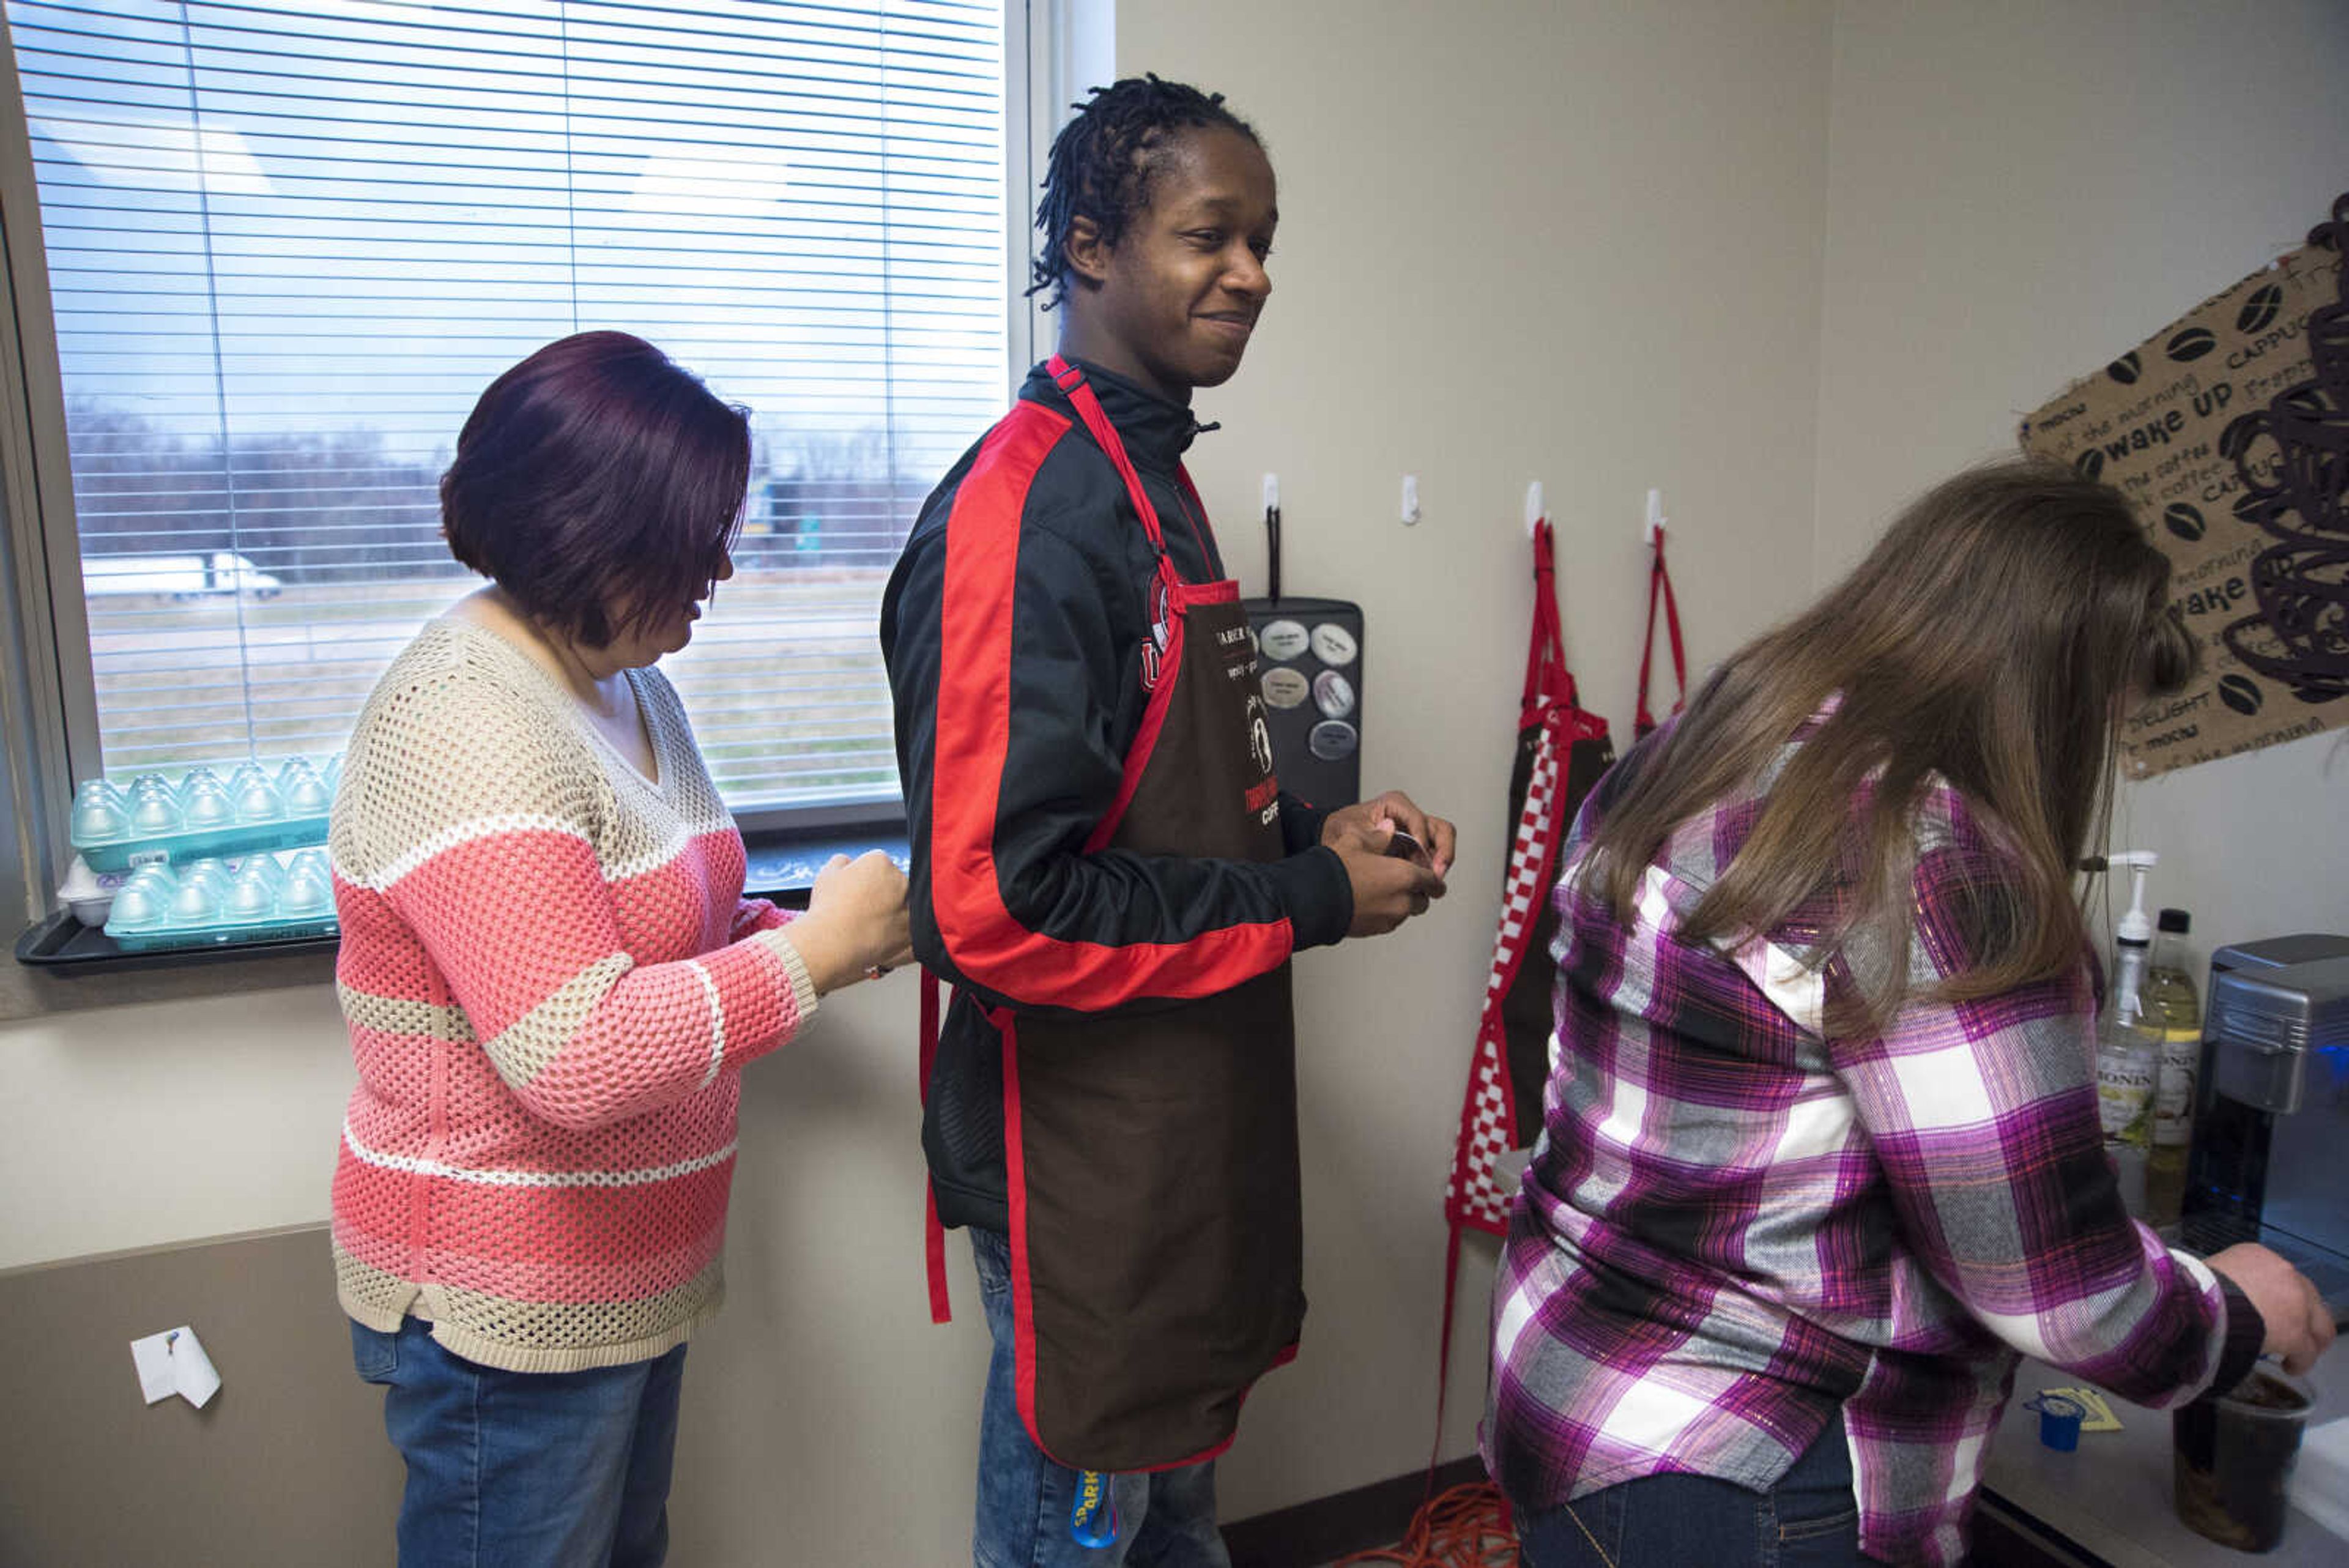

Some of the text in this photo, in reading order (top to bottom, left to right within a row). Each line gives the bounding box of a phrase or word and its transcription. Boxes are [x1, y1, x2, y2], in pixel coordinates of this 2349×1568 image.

[2105, 409, 2180, 463] wake
[2193, 381, 2233, 418] UP
[1074, 1470, 1099, 1528] SPARK
